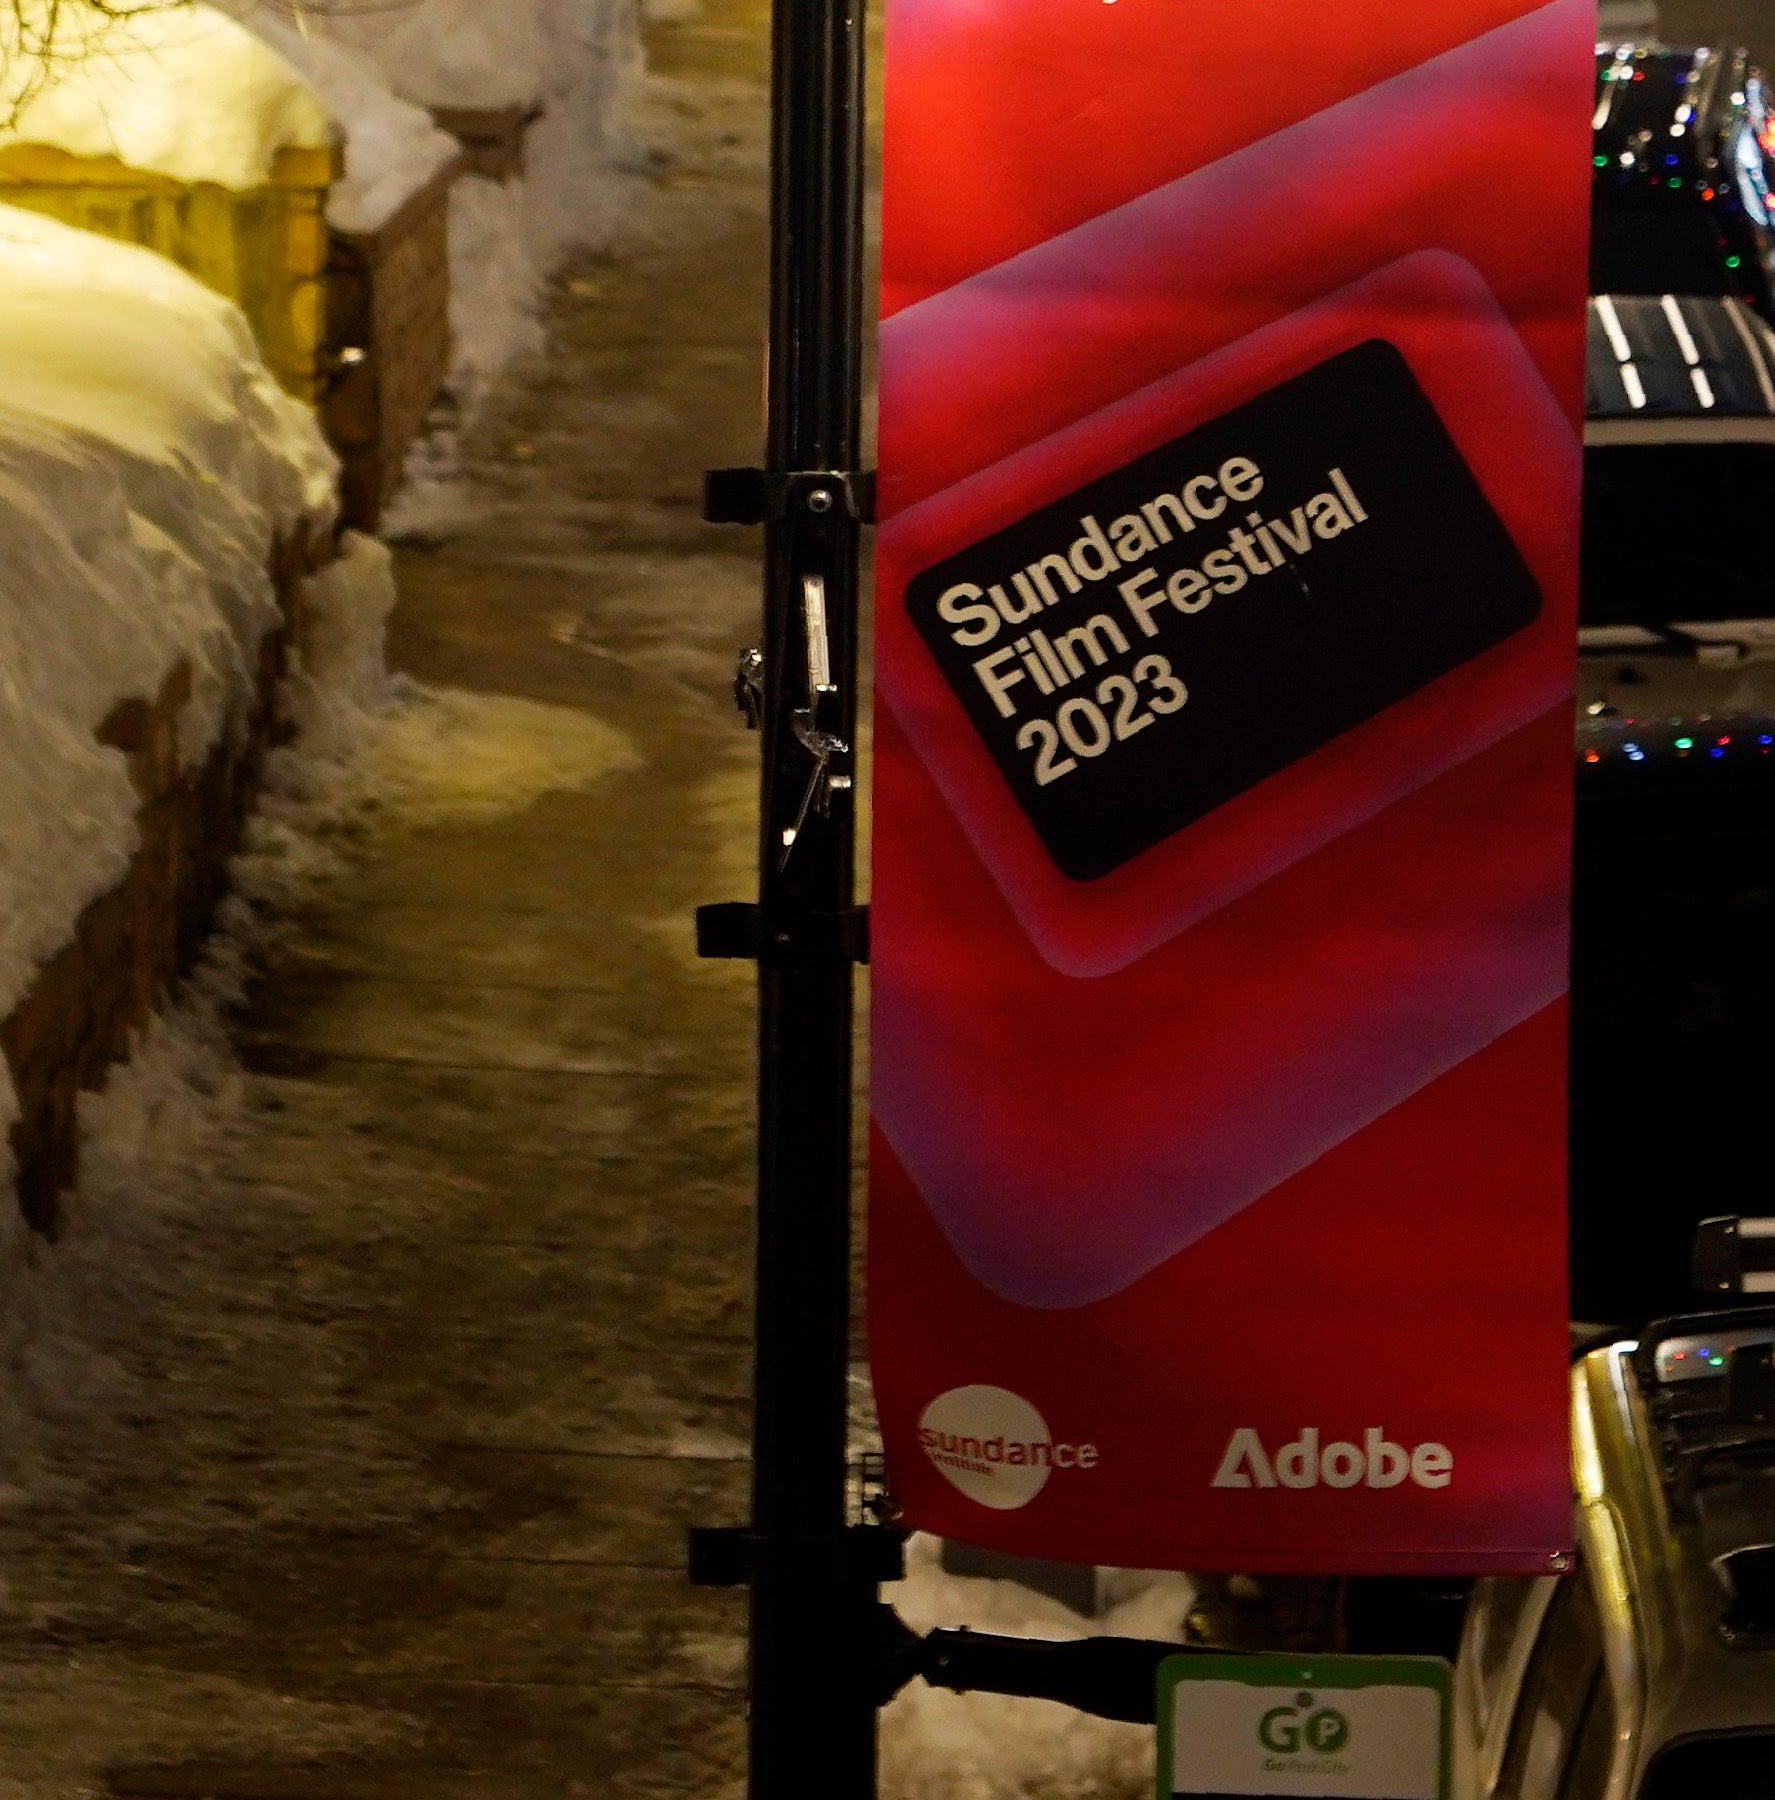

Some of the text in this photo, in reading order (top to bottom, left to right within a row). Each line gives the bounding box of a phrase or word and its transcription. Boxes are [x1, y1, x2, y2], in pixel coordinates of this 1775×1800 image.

[936, 456, 1264, 646] Sundance
[972, 468, 1369, 718] Film Festival
[1016, 654, 1188, 786] 2023
[917, 1428, 1099, 1469] sundance
[1210, 1426, 1453, 1488] Adobe
